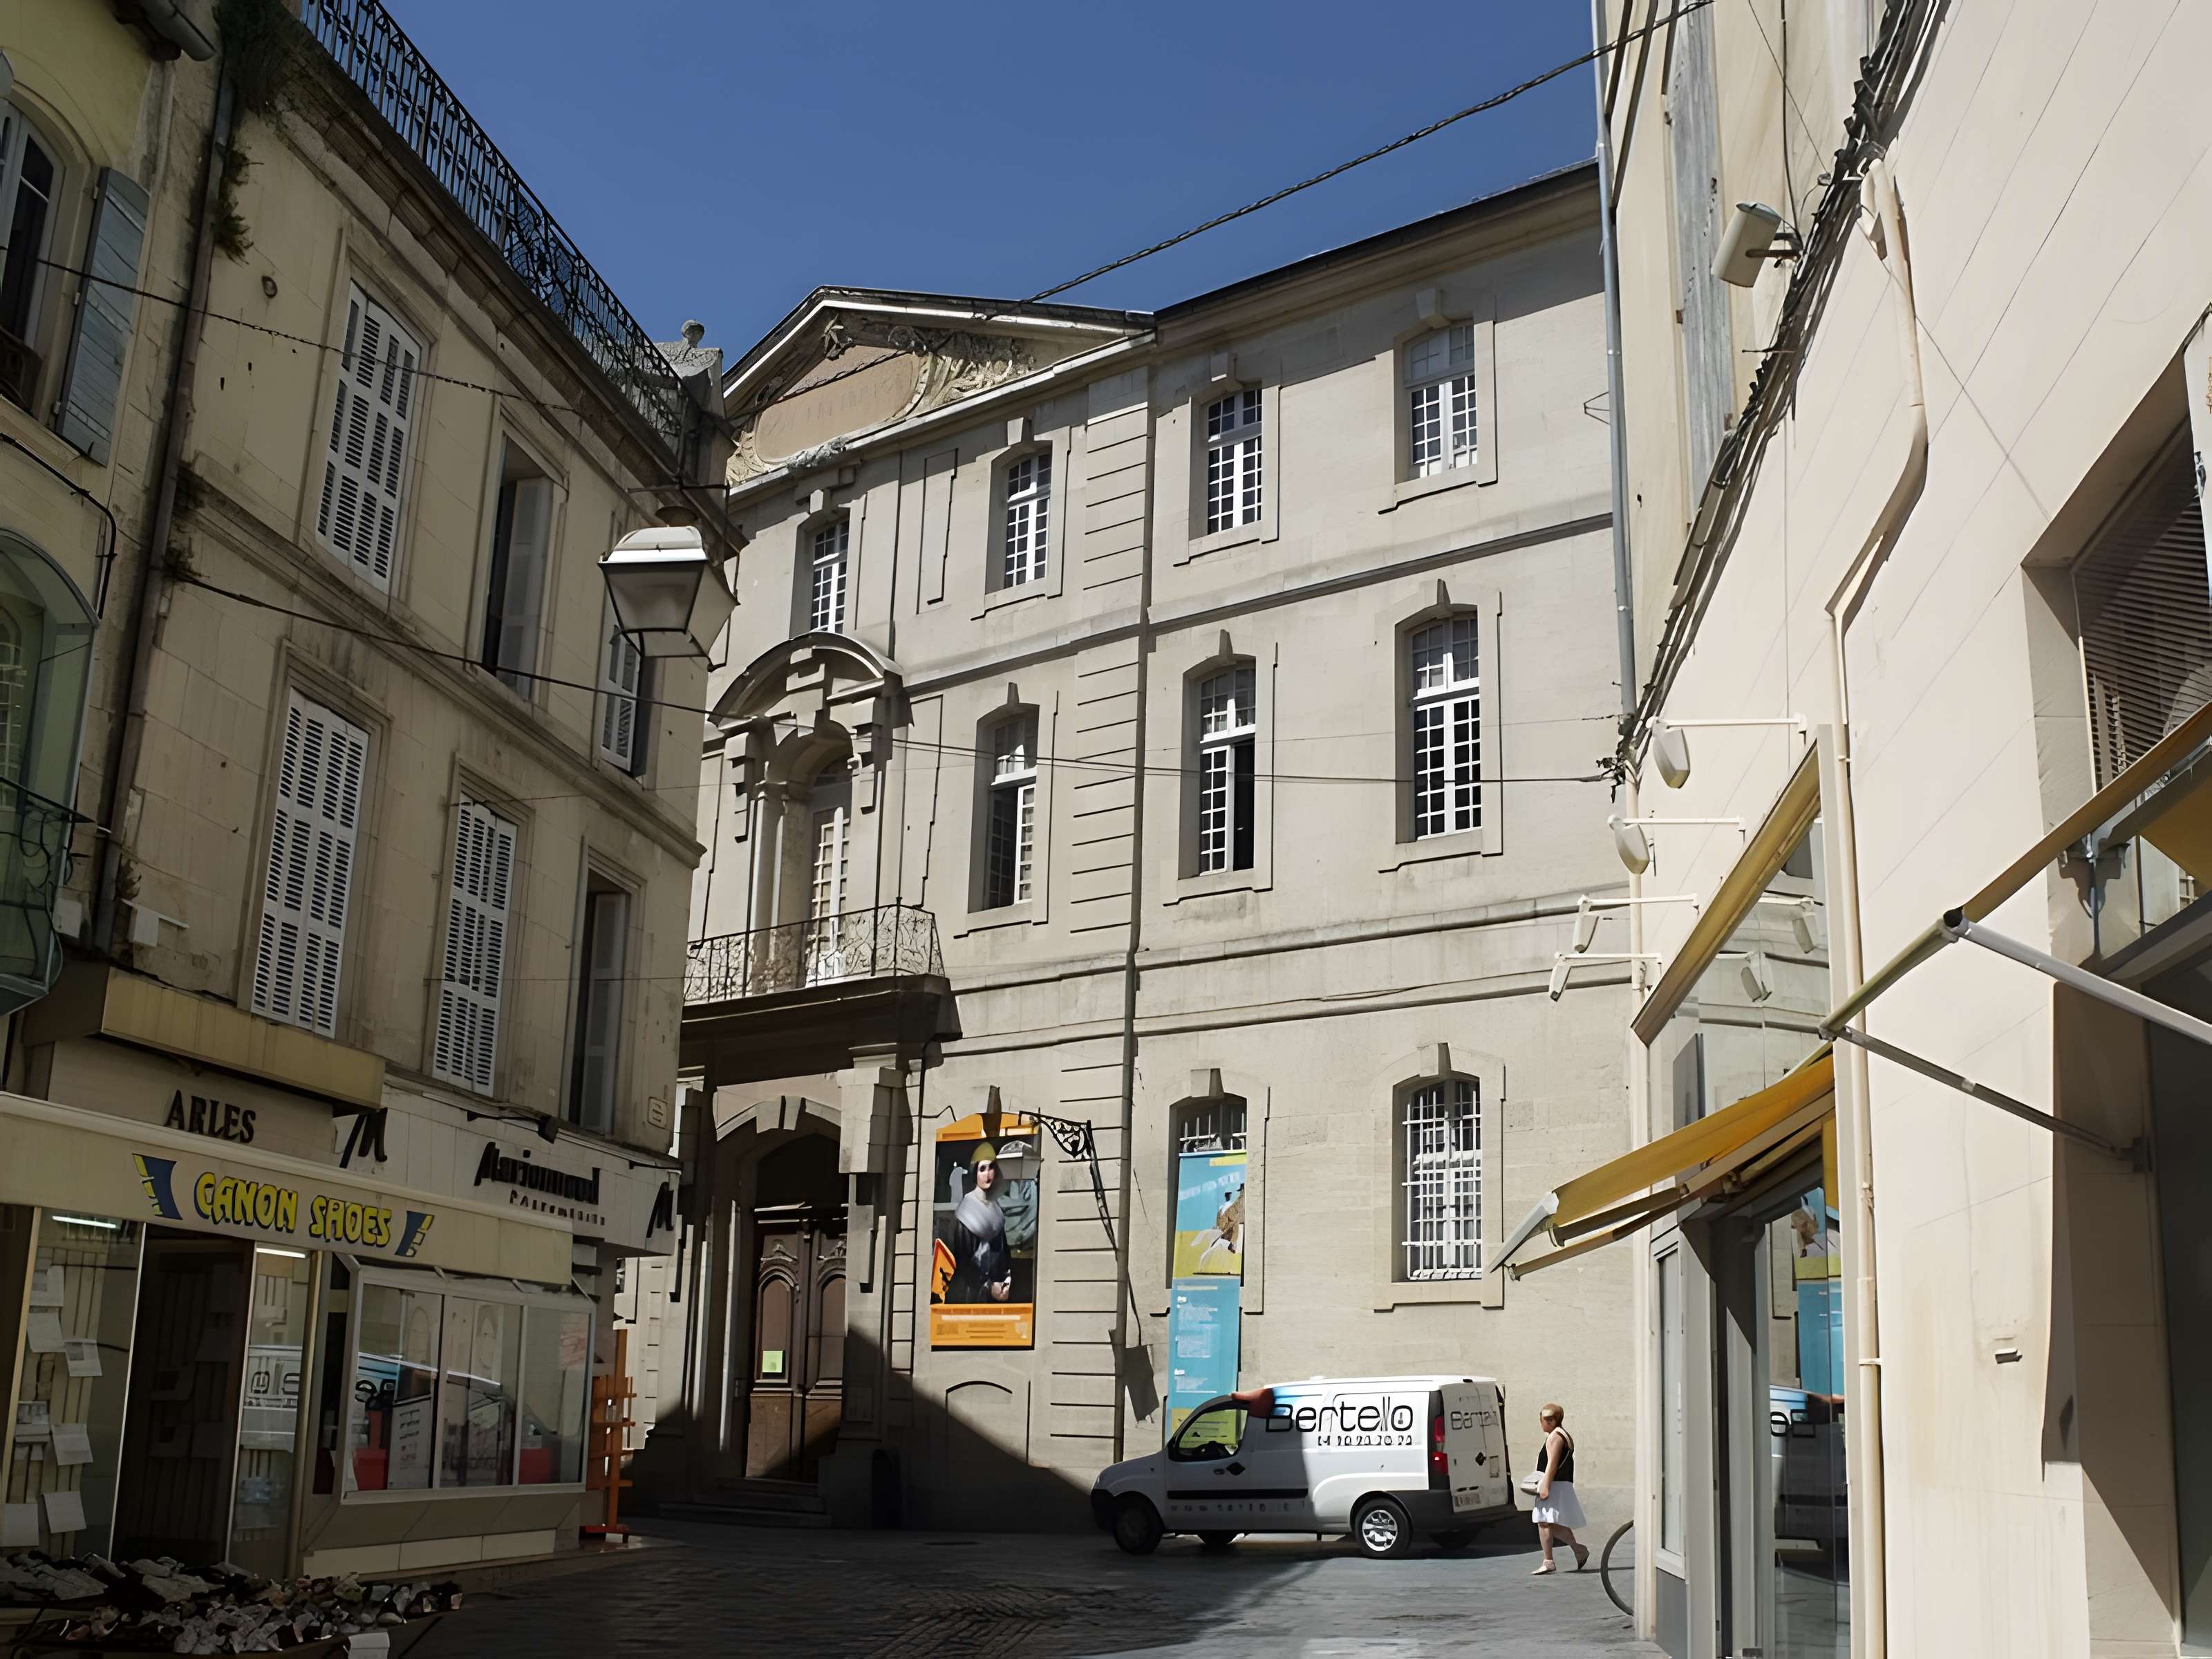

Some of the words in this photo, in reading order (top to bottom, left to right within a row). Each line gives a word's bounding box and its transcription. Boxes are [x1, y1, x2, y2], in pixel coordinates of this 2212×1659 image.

[164, 1089, 256, 1143] ARLES
[194, 1172, 299, 1234] CANON
[1265, 1396, 1414, 1433] Bertello
